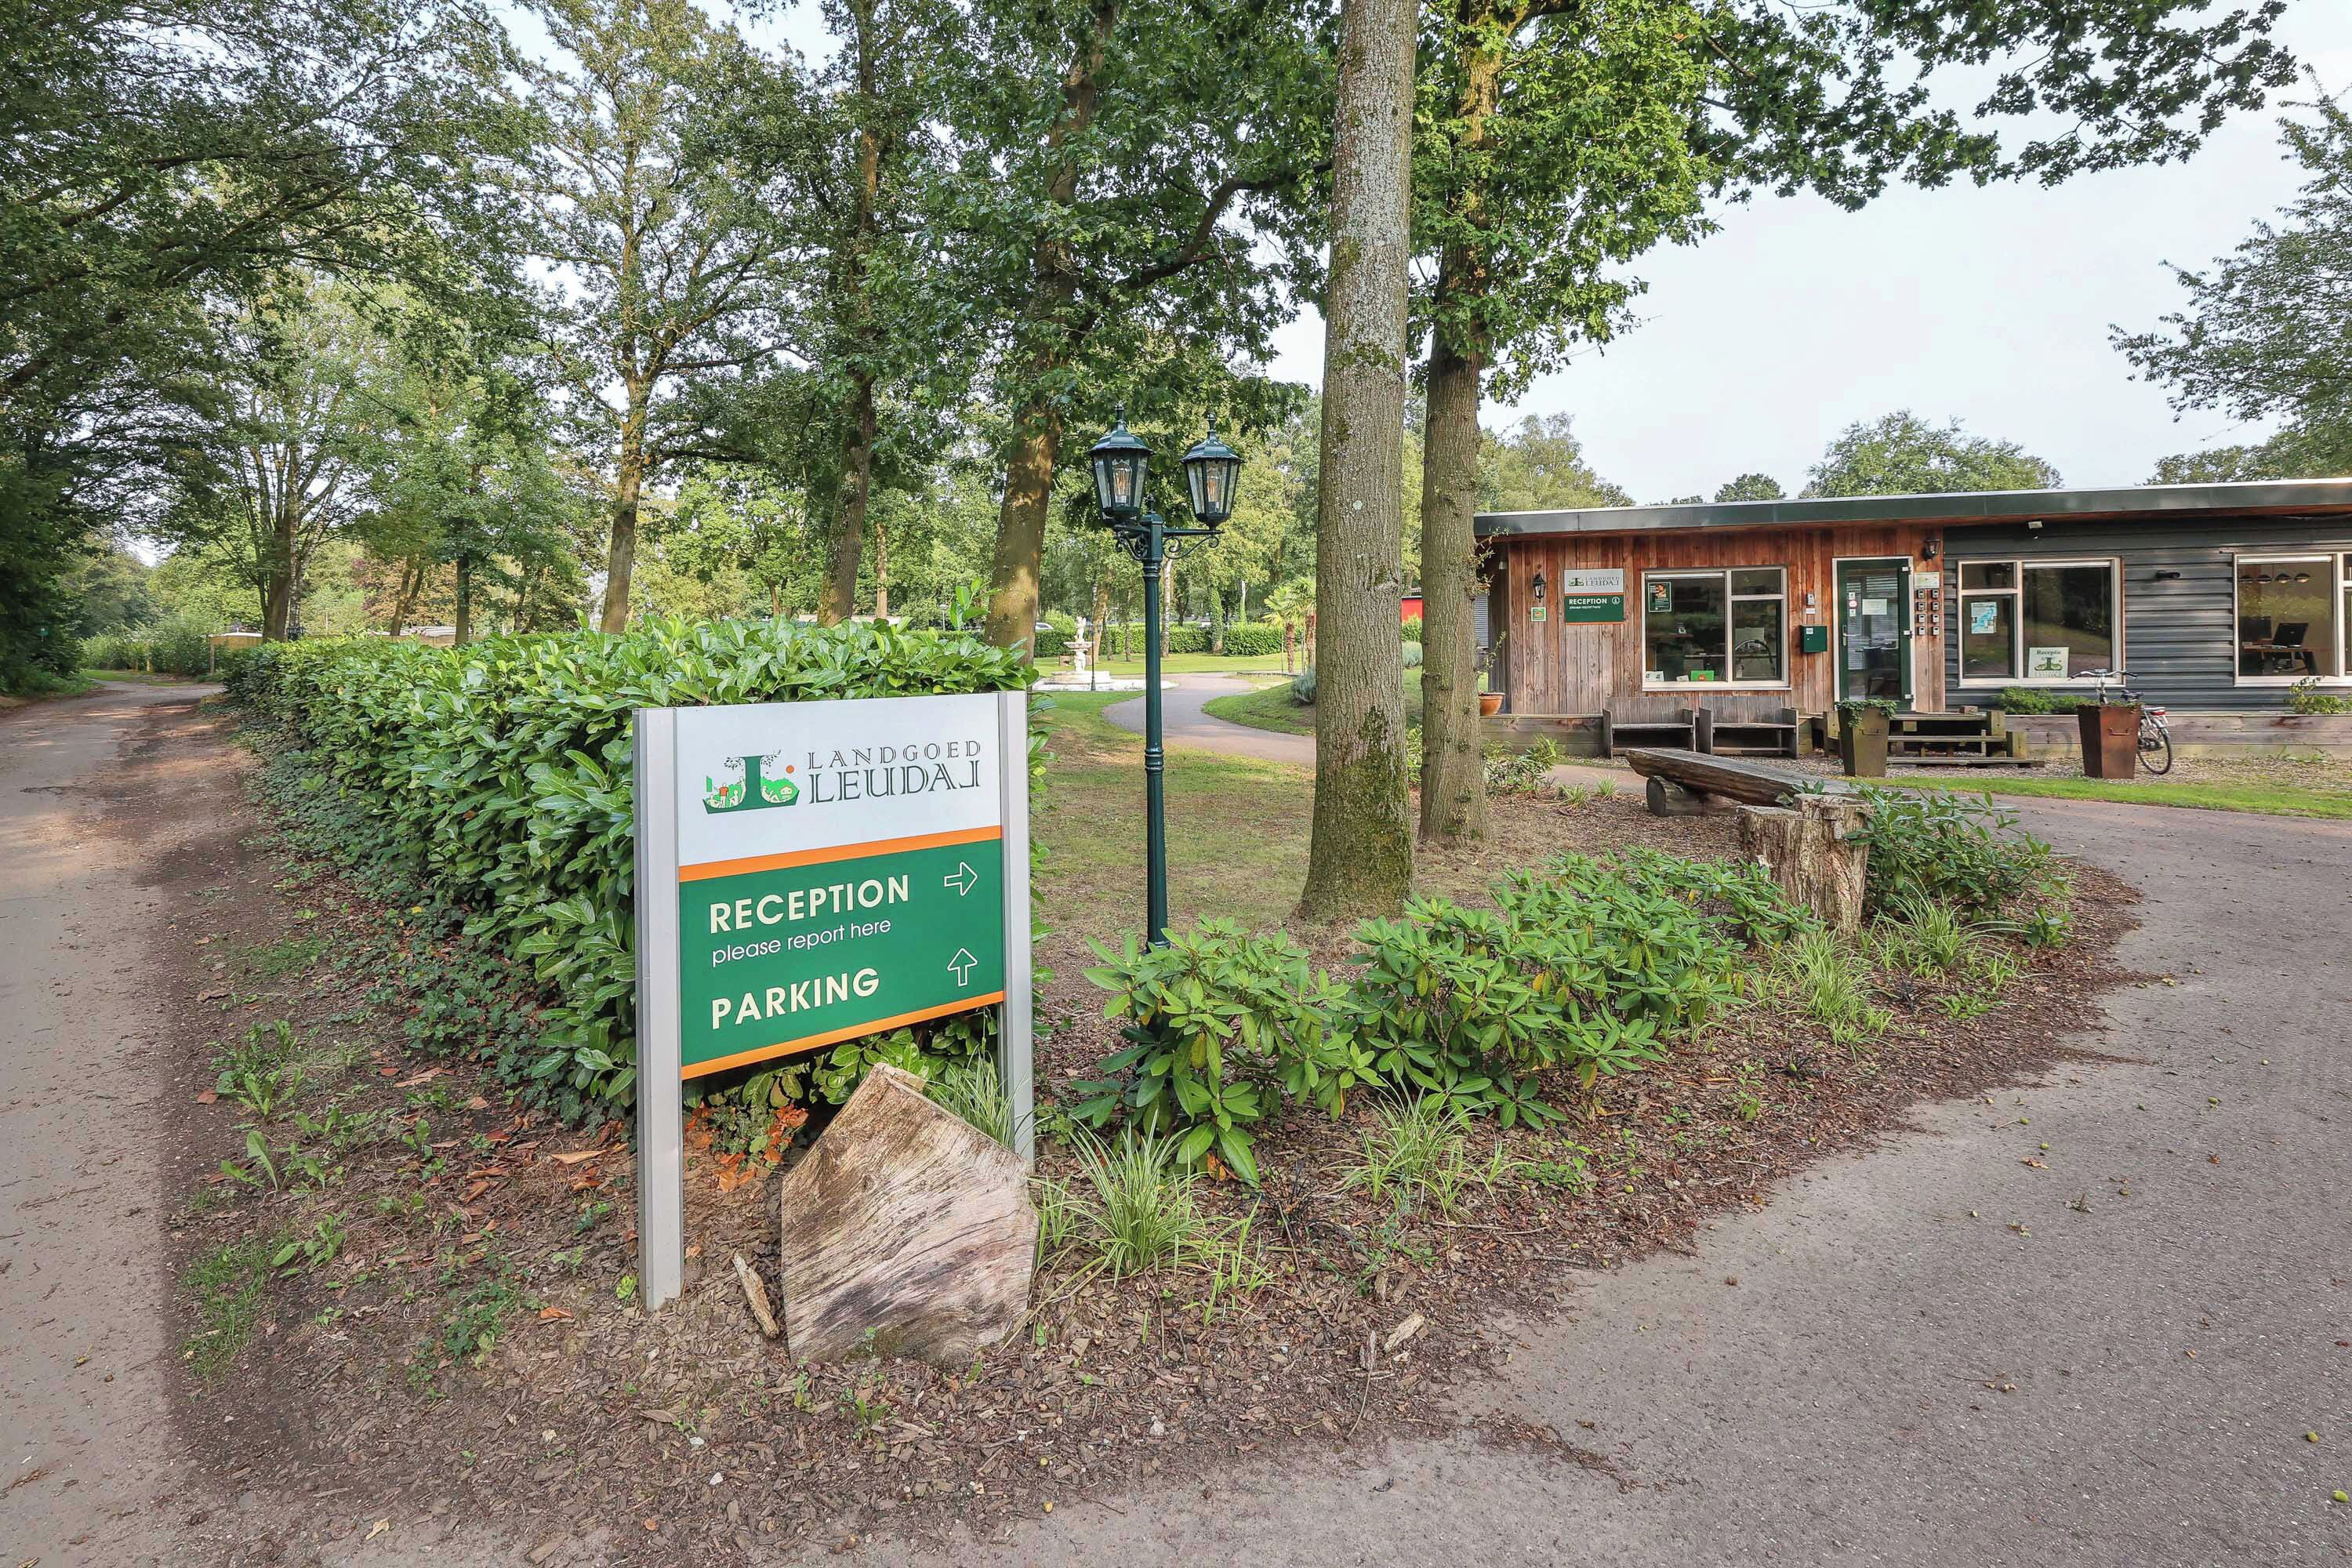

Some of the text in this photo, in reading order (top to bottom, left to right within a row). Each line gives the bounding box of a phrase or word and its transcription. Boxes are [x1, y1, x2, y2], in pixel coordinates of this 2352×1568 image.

[808, 740, 980, 771] LANDGOED
[709, 874, 909, 935] RECEPTION
[712, 918, 892, 967] please report here
[711, 967, 880, 1029] PARKING
